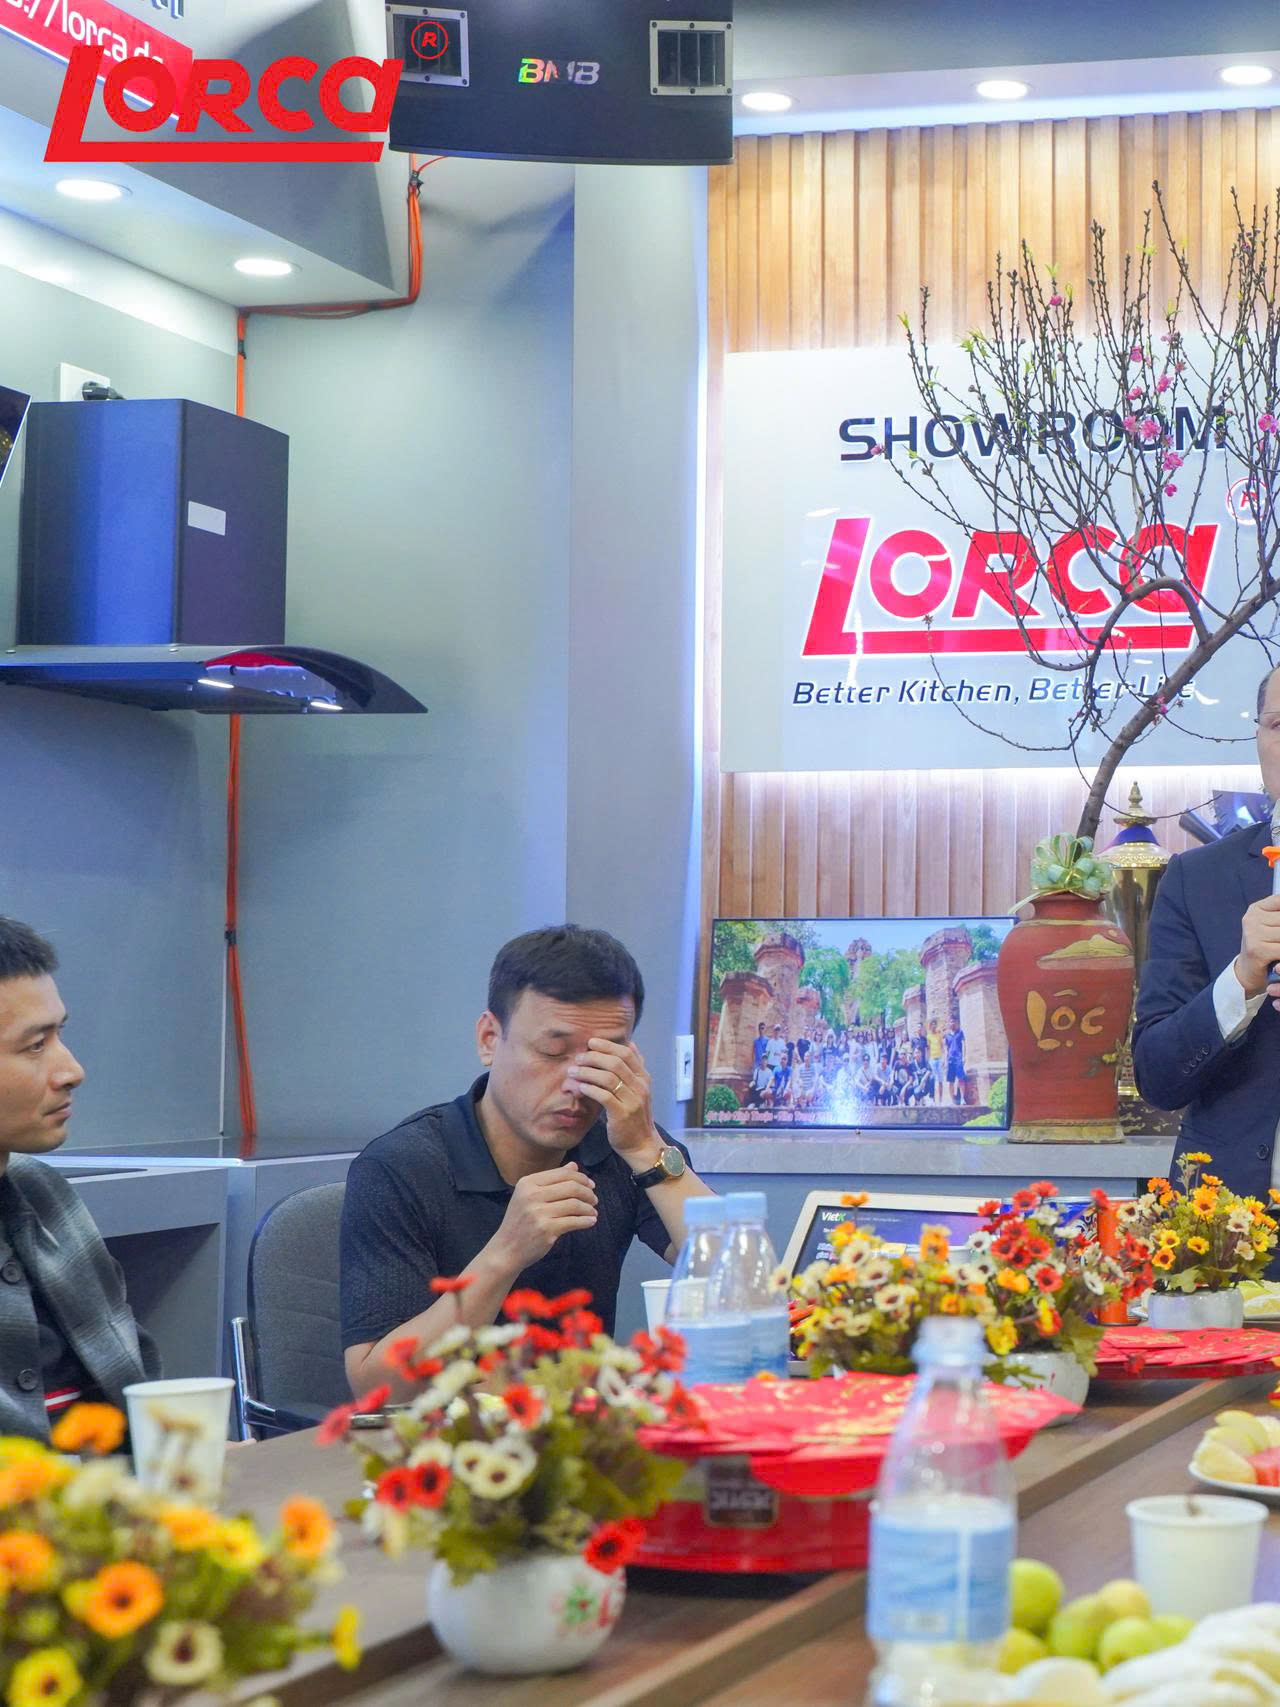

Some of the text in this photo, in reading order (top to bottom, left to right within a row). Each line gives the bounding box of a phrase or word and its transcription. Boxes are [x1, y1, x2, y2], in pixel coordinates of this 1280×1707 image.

[839, 406, 1226, 461] SHOWROOM
[793, 675, 1194, 706] Better Kitchen, Beter Lie
